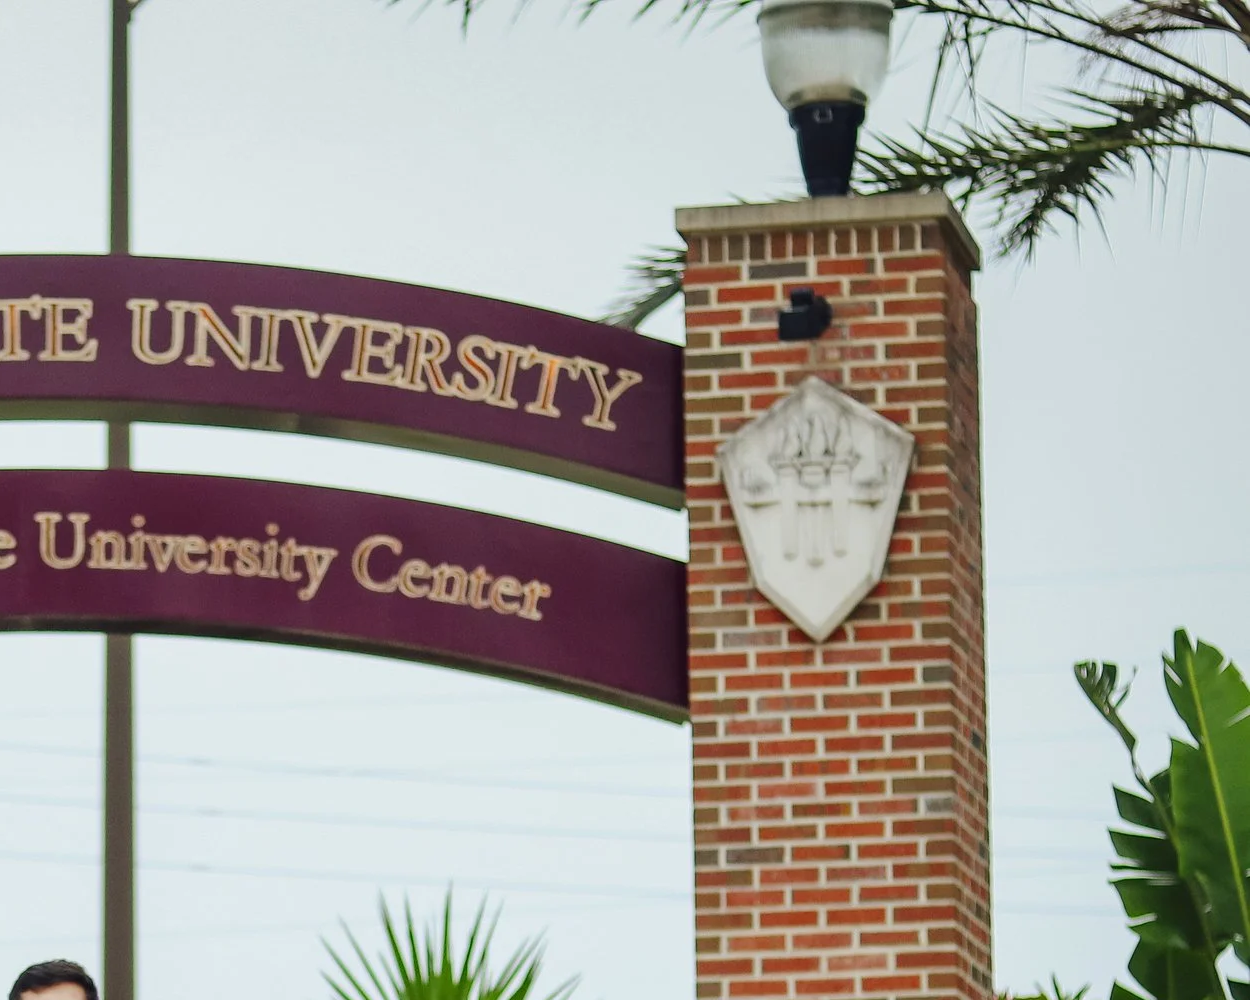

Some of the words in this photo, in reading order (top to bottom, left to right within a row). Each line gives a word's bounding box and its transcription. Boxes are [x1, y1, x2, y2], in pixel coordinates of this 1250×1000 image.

[128, 299, 642, 431] UNIVERSITY
[36, 512, 337, 601] University
[351, 534, 552, 622] Center
